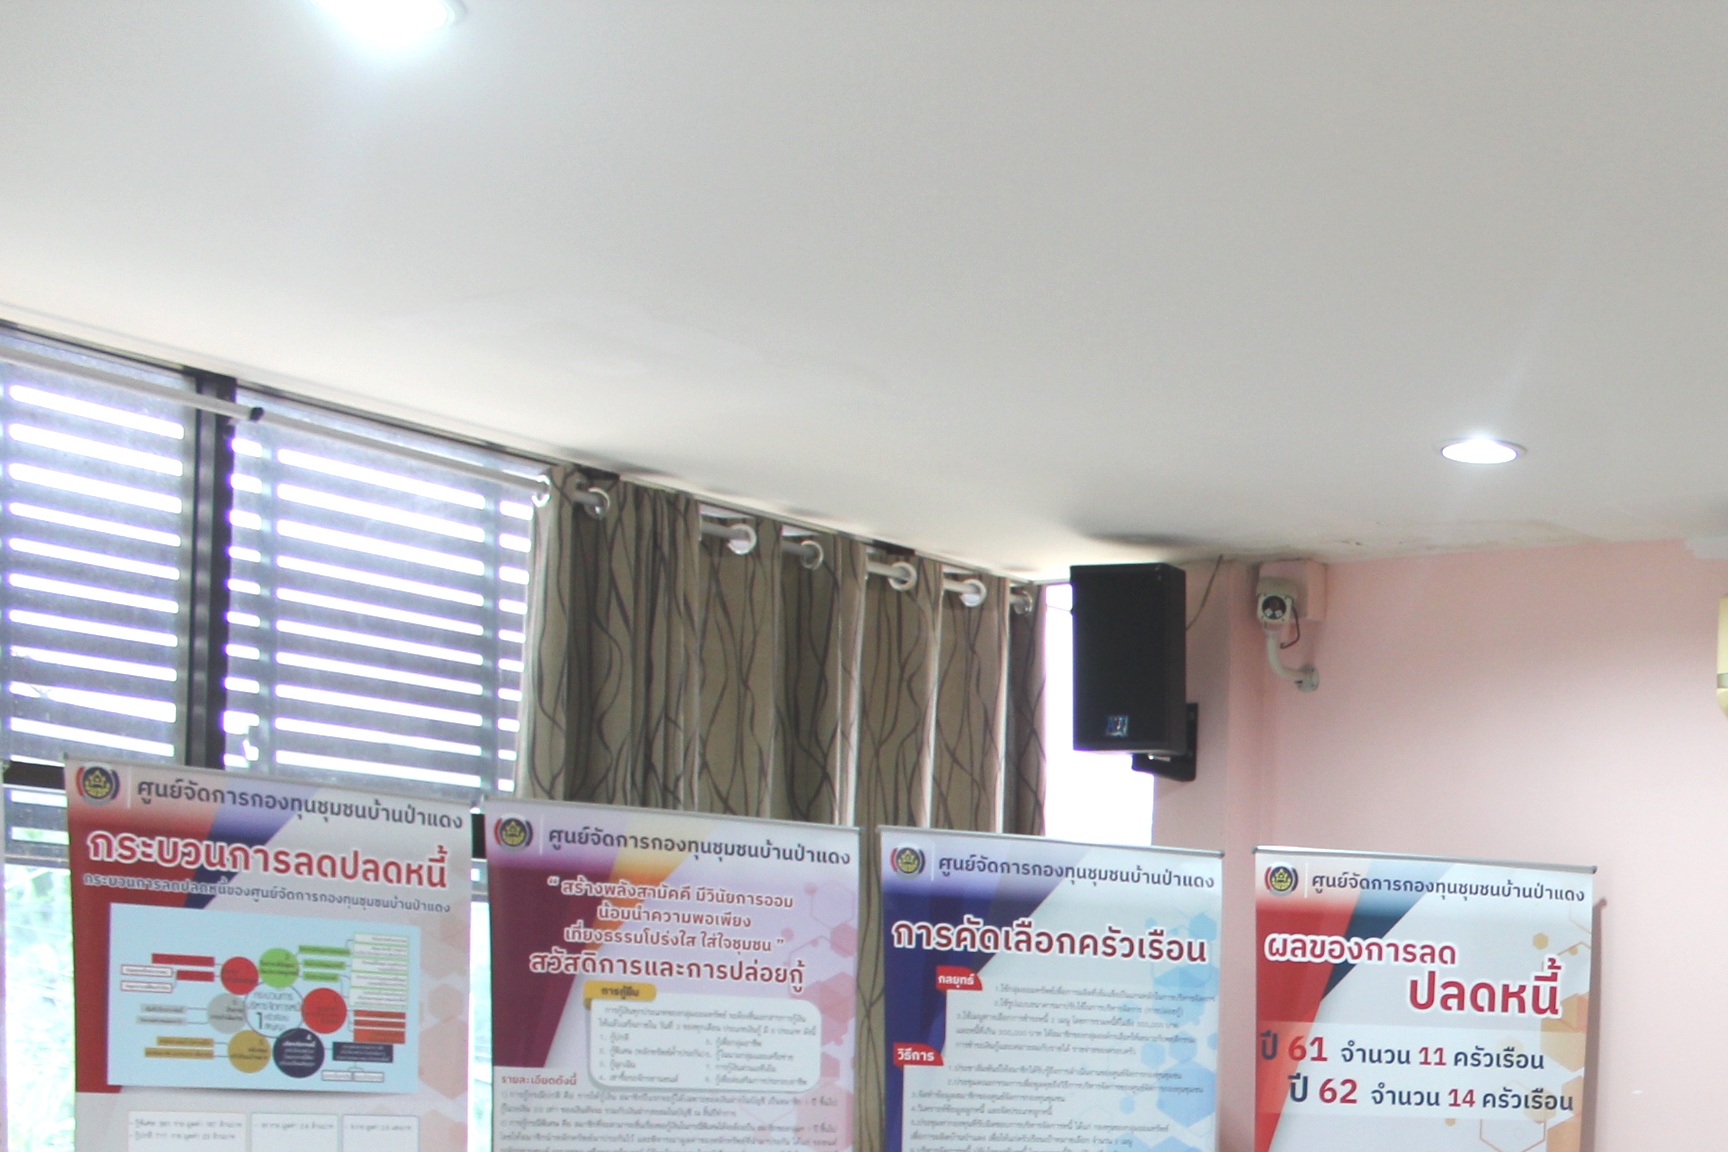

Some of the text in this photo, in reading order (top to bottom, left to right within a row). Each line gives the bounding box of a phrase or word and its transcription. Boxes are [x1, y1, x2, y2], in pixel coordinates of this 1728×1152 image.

[137, 777, 463, 830] ศูนย์จัดการกองทุนชุมชนบ้านป่าแดง
[87, 833, 448, 889] กระบวนการลดปลดหนี้
[548, 825, 851, 866] ศูนย์จัดการกองทุนชุมชนบ้านป่าแดง
[938, 853, 1215, 889] ศูนย์จัดการกองทุนชุมชนบ้านป่าแดง
[1312, 871, 1585, 903] ศูนย์จัดการกองทุนชุมชนบ้านป่าแดง
[597, 904, 752, 928] น้อมนำความพอเพียง
[695, 887, 794, 909] มีวินัยการออม
[563, 920, 697, 947] เที่ยงธรรมโปร่งใส
[700, 930, 772, 955] ใส่ใจชุมชน
[893, 915, 1207, 963] การคัดเลือกครัวเรือน
[1267, 936, 1457, 965] ผลของการลด
[529, 946, 806, 994] สวัสดิการและการปล่อยกู้
[1409, 957, 1562, 1016] ปลดหนี้
[897, 1046, 935, 1062] วิธีการ
[1259, 1029, 1545, 1070] ปี 61 จำนวน 11 ครัวเรือน
[1287, 1072, 1574, 1112] ปี 62 จำนวน 14 ครัวเรือน
